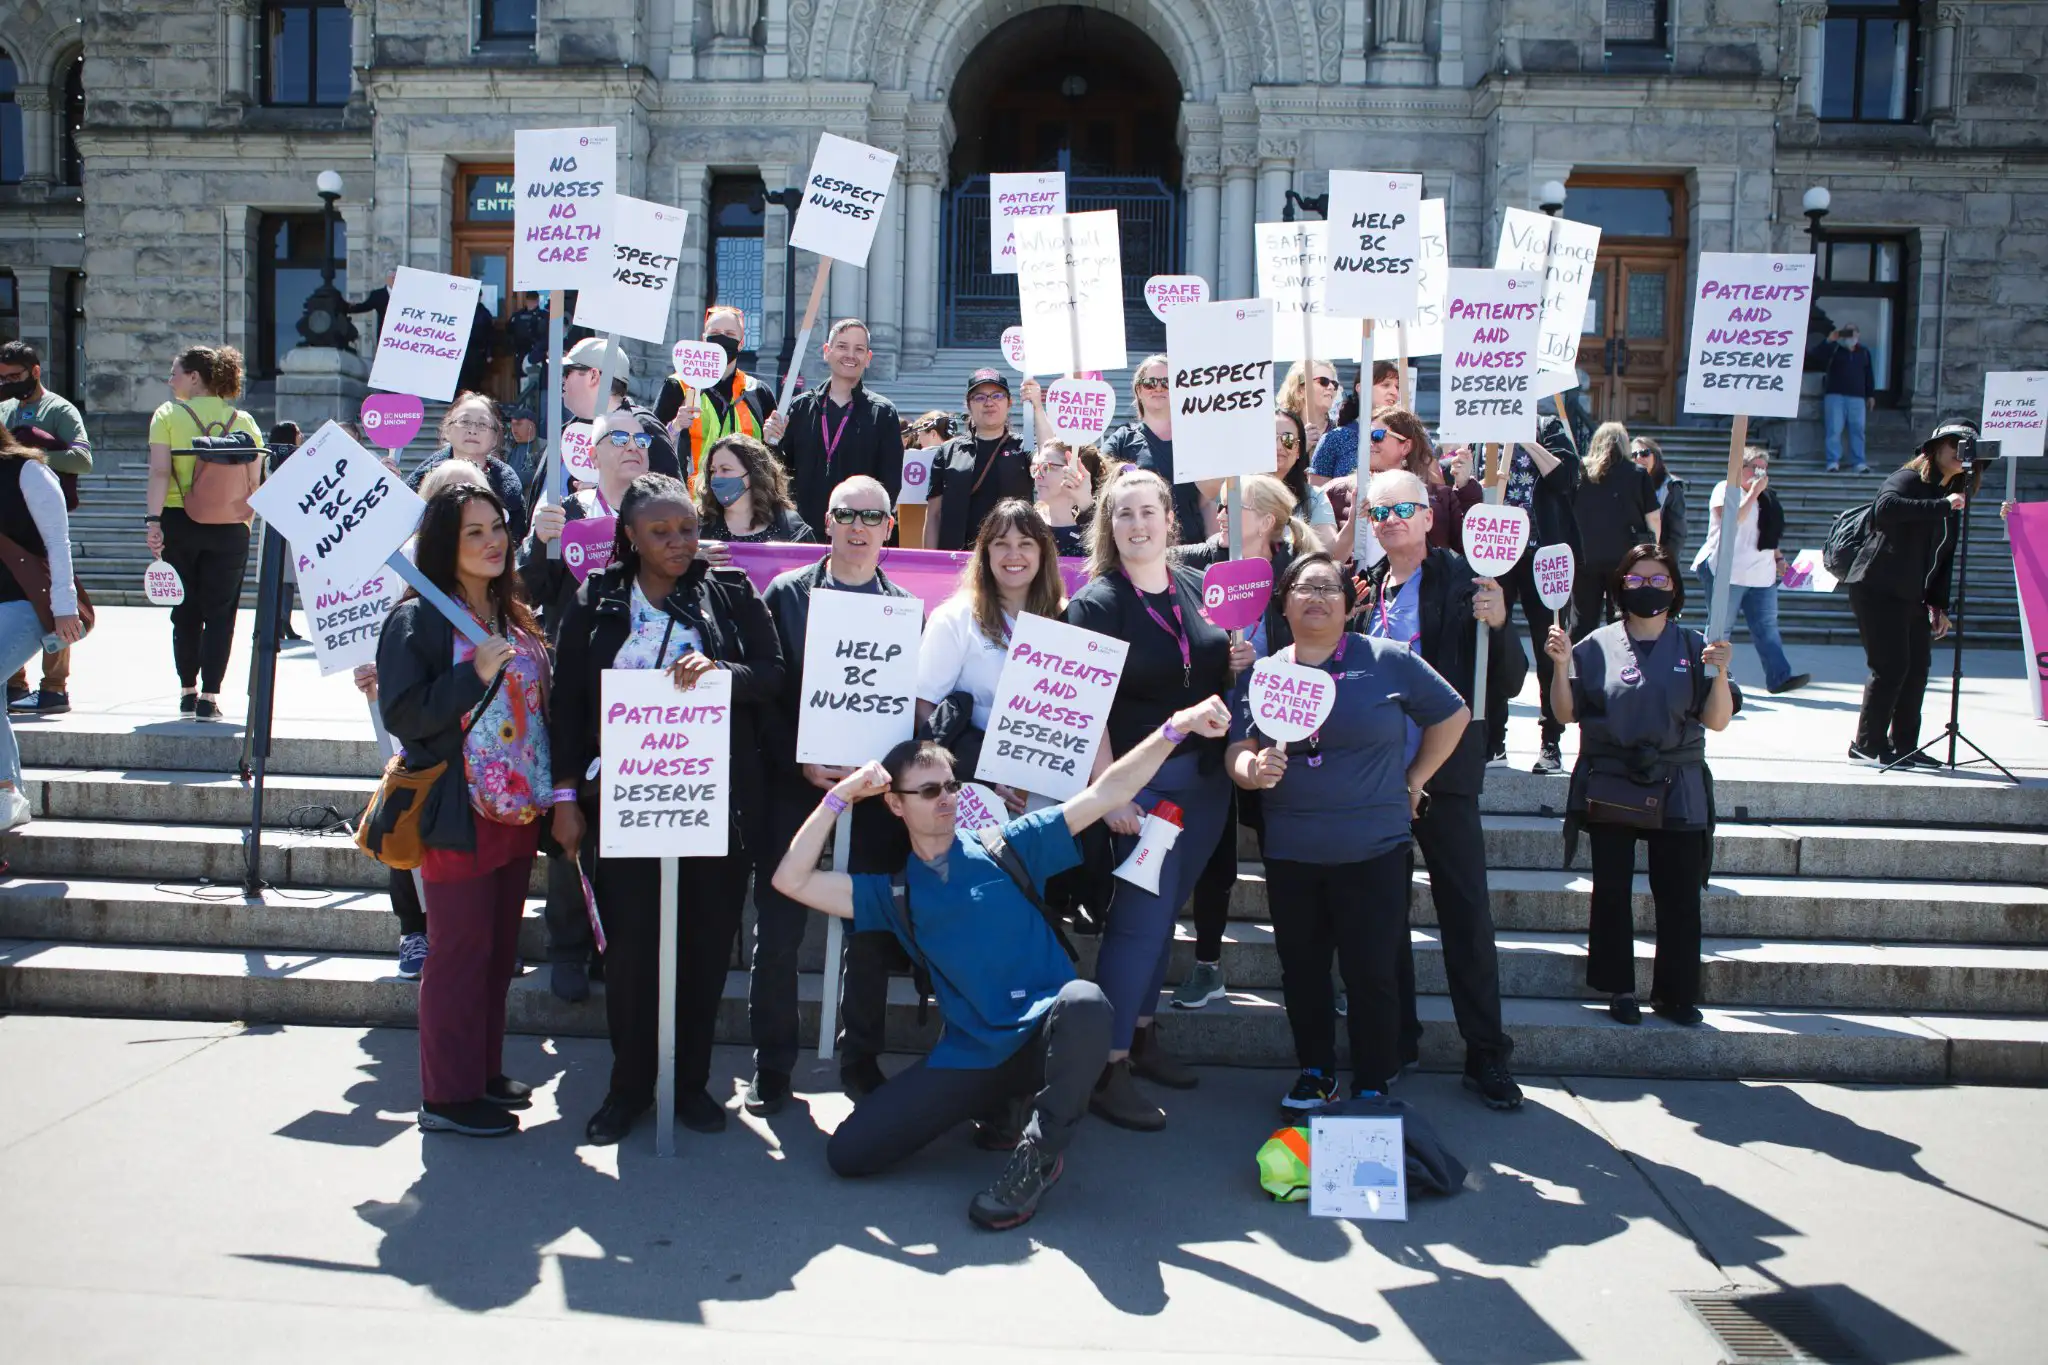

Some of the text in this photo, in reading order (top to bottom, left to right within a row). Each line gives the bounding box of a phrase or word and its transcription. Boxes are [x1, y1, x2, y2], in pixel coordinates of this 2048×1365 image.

[549, 156, 578, 173] NO
[495, 181, 515, 193] MA
[527, 181, 604, 198] NURSES
[811, 174, 885, 205] RESPECT
[477, 198, 516, 211] ENTR
[809, 192, 875, 221] NURSES
[998, 191, 1061, 204] PATIENT
[548, 203, 577, 219] NO
[1003, 204, 1056, 217] SAFETY
[1351, 212, 1406, 231] HELP
[526, 224, 601, 242] HEALTH
[1265, 231, 1320, 250] SAFE
[1508, 221, 1597, 264] Violence
[1359, 234, 1387, 252] BC
[537, 246, 590, 263] CARE
[613, 244, 678, 271] SPECT
[1271, 252, 1327, 269] STAFFI
[1333, 255, 1414, 275] NURSES
[1545, 264, 1584, 285] not
[613, 267, 669, 291] RSES
[1147, 284, 1201, 295] #SAFE
[1157, 295, 1201, 303] PATIENT
[1701, 280, 1810, 301] PATIENTS
[401, 307, 458, 326] FIX THE
[1449, 298, 1538, 320] PATIENTS
[1727, 306, 1773, 323] AND
[393, 322, 457, 343] NURSING
[1472, 327, 1510, 344] AND
[1705, 328, 1794, 346] NURSES
[383, 337, 462, 361] SHORTAGE!
[675, 348, 721, 362] #SAFE
[683, 359, 720, 369] PATIENT
[1455, 350, 1527, 369] NURSES
[1699, 350, 1794, 369] DESERVE
[682, 366, 720, 379] CARE
[1175, 360, 1273, 389] RESPECT
[1702, 372, 1784, 392] BETTER
[1451, 374, 1529, 393] DESERVE
[1049, 390, 1107, 407] #SAFE
[1181, 388, 1266, 416] NURSES
[1454, 398, 1523, 417] BETTER
[1994, 399, 2037, 407] FIX THE
[1058, 405, 1105, 417] PATIENT
[1057, 415, 1104, 431] CARE
[1984, 420, 2044, 429] SHORTAGE!
[564, 431, 593, 447] #SA
[571, 455, 597, 470] CA
[297, 458, 349, 515] HELP
[319, 488, 352, 521] BC
[315, 476, 390, 559] NURSES
[1465, 516, 1522, 535] #SAFE
[1474, 533, 1520, 546] PATIENT
[1472, 544, 1518, 561] CARE
[1534, 555, 1569, 573] #SAFE
[1541, 570, 1569, 581] PATIENT
[1227, 591, 1255, 602] UNION
[1542, 580, 1570, 596] CARE
[316, 596, 392, 632] DESERVE
[323, 620, 381, 651] BETTE
[835, 639, 902, 663] HELP
[1011, 642, 1118, 687] PATIENTS
[844, 666, 877, 687] BC
[1253, 671, 1325, 700] #SAFE
[1033, 678, 1078, 700] AND
[809, 689, 910, 715] NURSES
[1263, 690, 1321, 712] PATIENT
[607, 702, 727, 725] PATIENTS
[1008, 694, 1094, 730] NURSES
[1260, 703, 1318, 728] CARE
[640, 732, 690, 750] AND
[997, 714, 1090, 755] DESERVE
[618, 757, 715, 777] NURSES
[996, 739, 1076, 777] BETTER
[613, 783, 717, 802] DESERVE
[961, 785, 999, 829] ARE
[618, 808, 710, 828] BETTER
